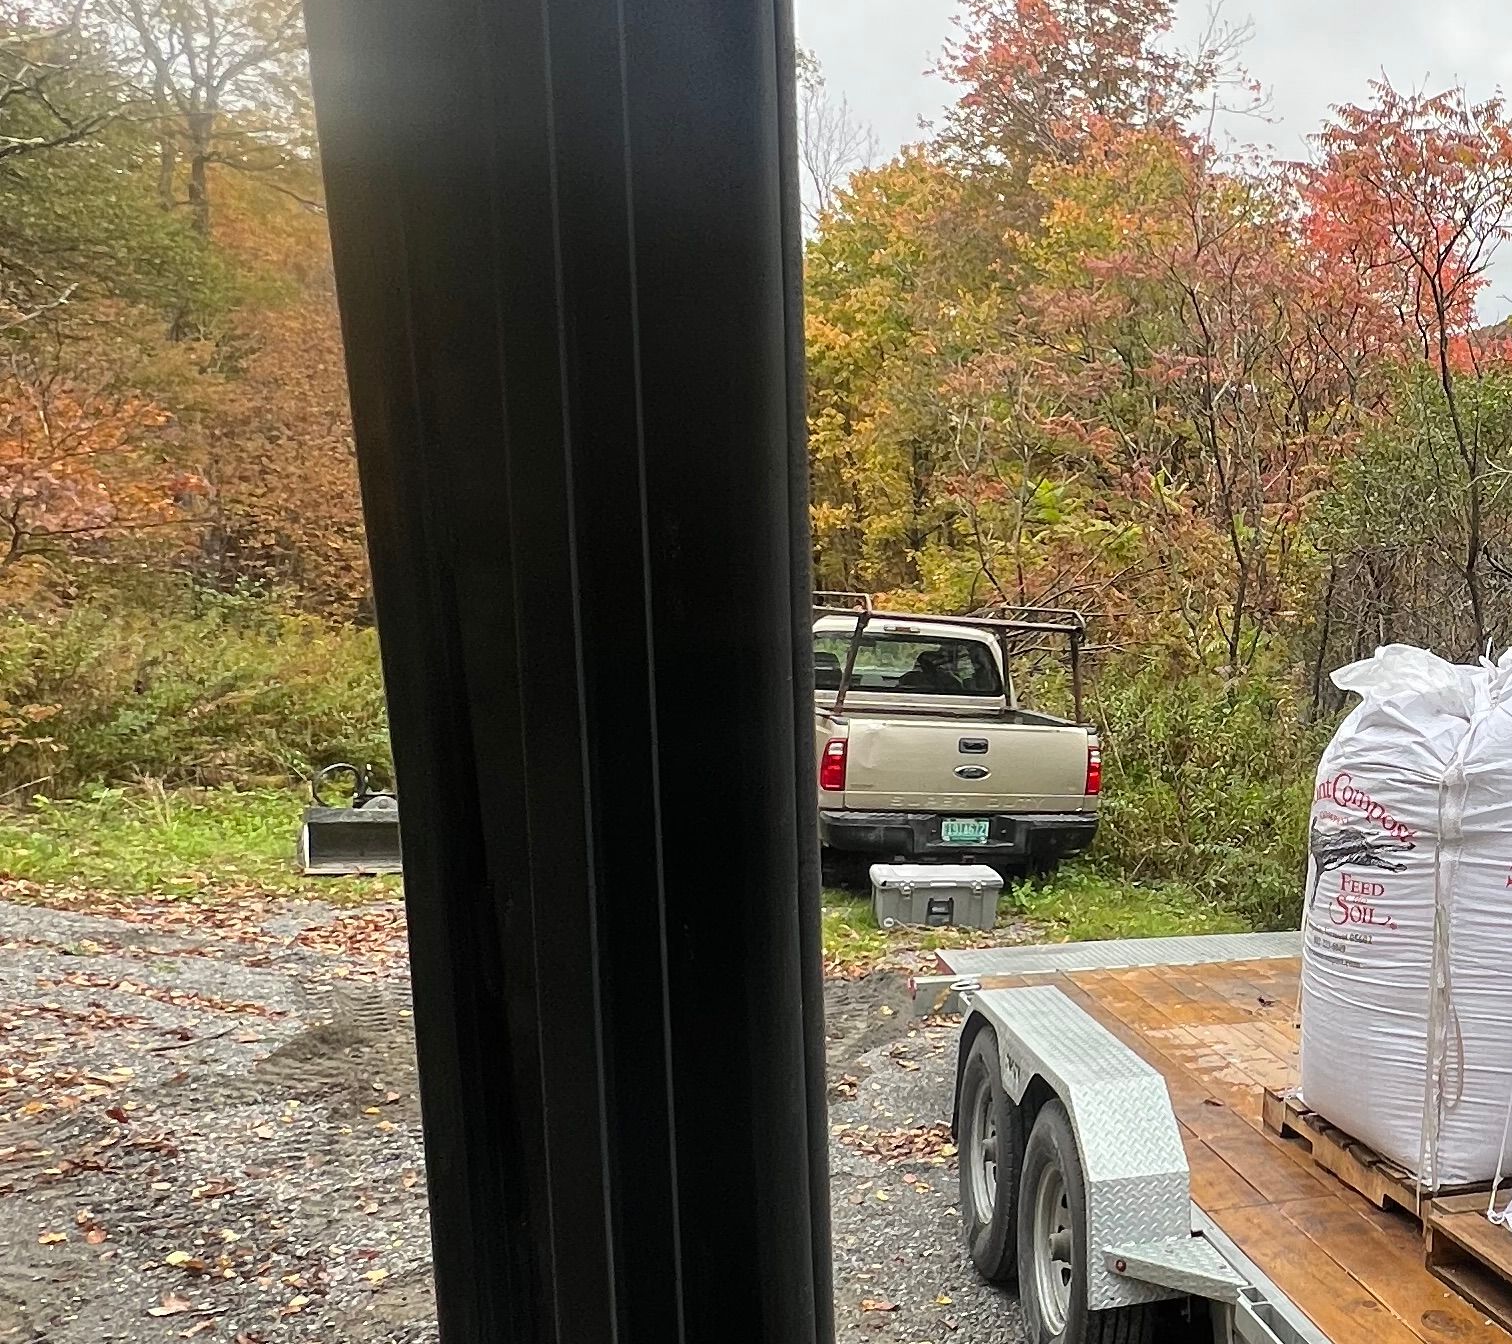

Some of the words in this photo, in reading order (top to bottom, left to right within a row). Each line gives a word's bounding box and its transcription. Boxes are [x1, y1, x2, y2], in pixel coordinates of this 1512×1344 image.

[1333, 772, 1418, 843] Compost
[1340, 871, 1385, 897] FEED
[1328, 894, 1392, 926] SOIL
